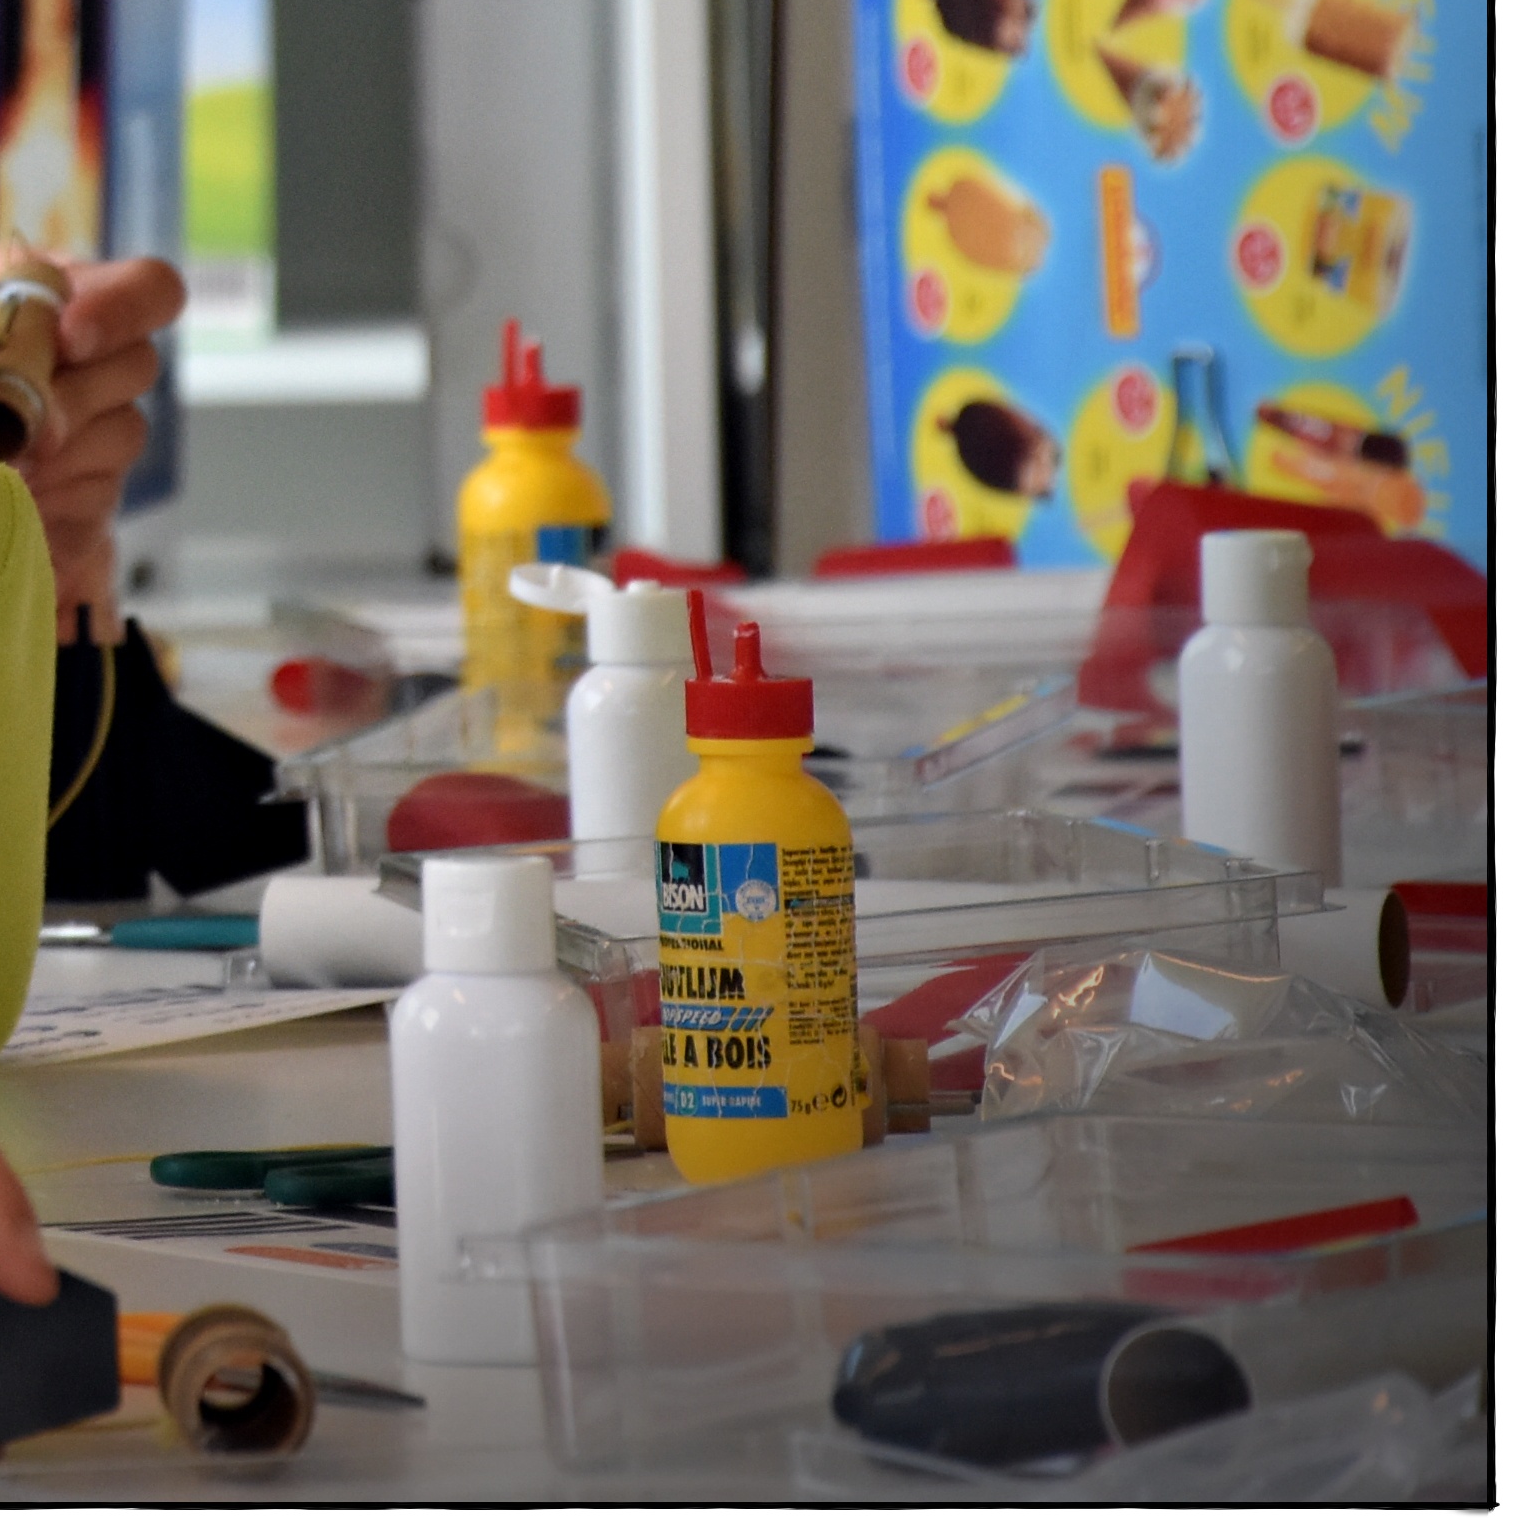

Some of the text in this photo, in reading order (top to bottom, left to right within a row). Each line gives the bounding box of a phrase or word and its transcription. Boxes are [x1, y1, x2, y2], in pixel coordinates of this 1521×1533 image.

[662, 882, 705, 911] BISON
[684, 1035, 699, 1068] A
[707, 1035, 772, 1070] BOIS
